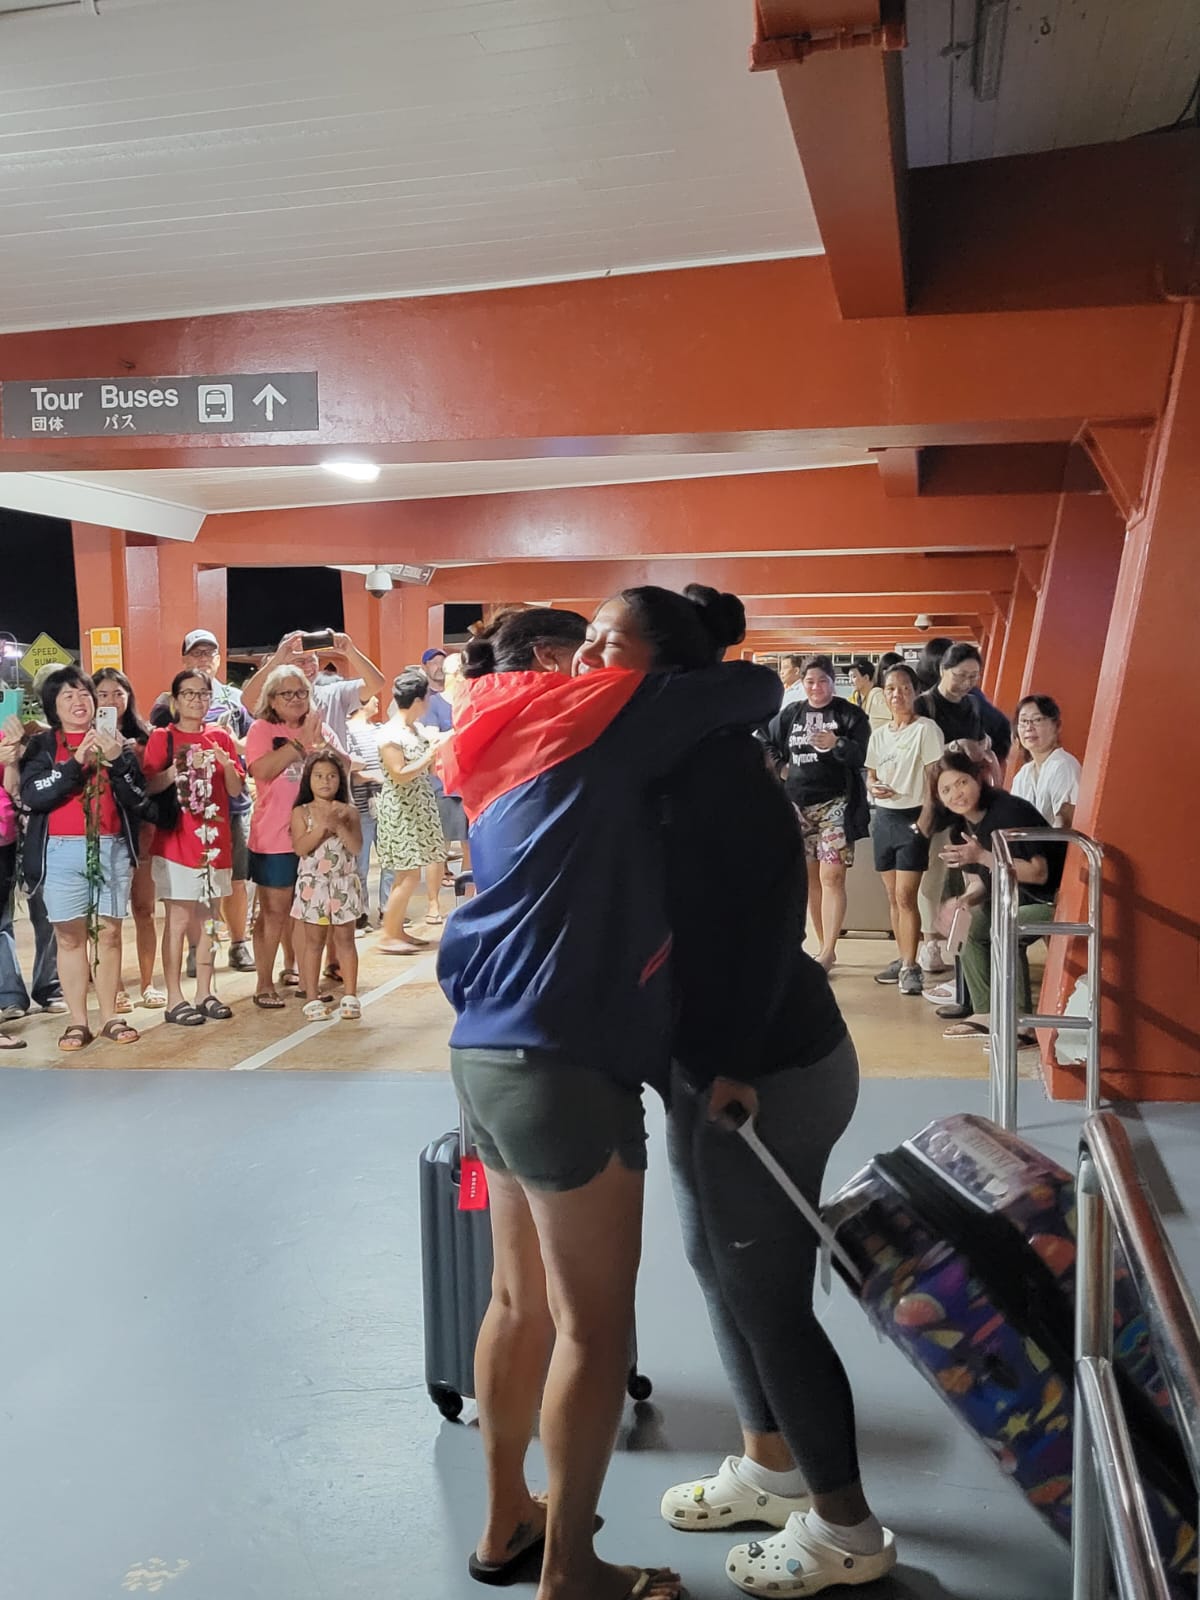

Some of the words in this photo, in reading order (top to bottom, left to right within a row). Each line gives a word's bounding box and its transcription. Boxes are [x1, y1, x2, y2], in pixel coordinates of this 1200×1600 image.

[31, 387, 83, 411] Tour
[101, 385, 179, 410] Buses
[31, 416, 64, 432] 団体
[103, 414, 137, 430] バス
[32, 648, 58, 656] SPEED
